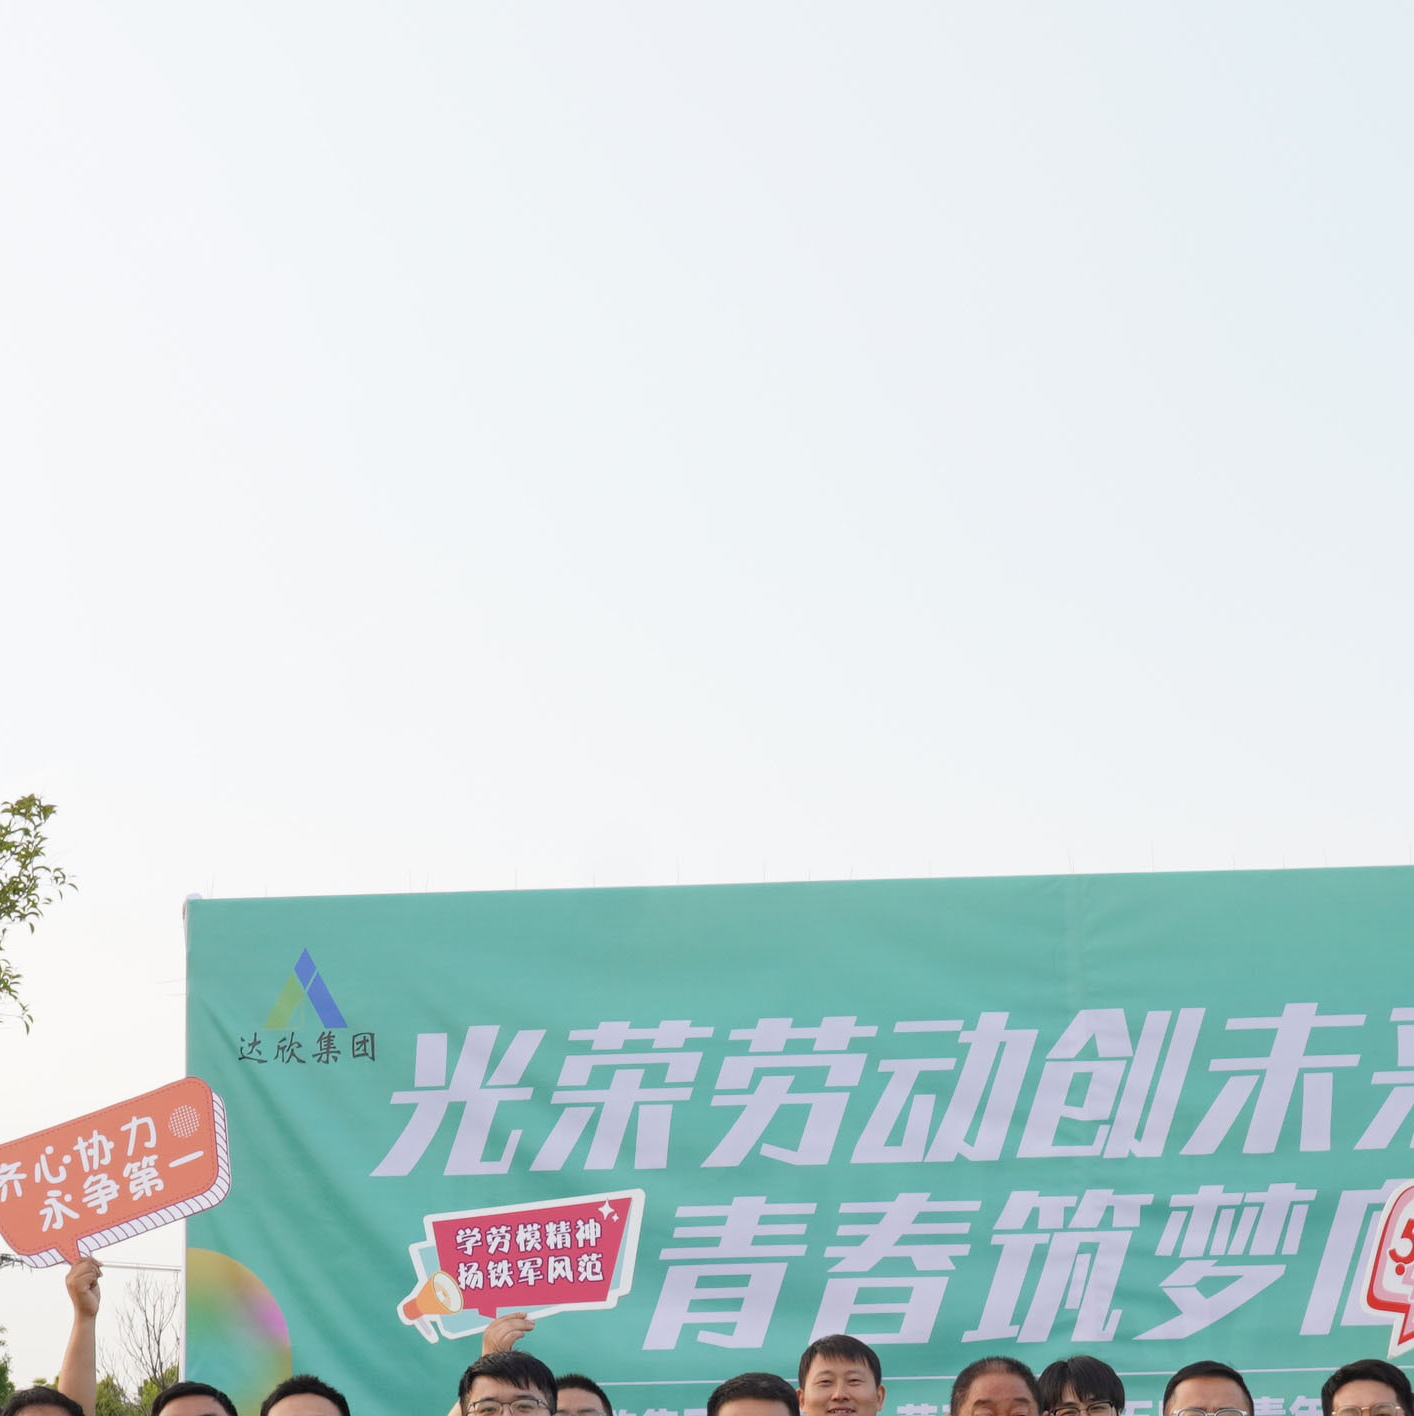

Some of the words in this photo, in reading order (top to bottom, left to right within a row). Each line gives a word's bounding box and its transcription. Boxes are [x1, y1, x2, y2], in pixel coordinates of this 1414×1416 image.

[238, 1032, 375, 1064] 达欣集团
[39, 1151, 204, 1232] 永争第一
[455, 1218, 602, 1256] 学劳模精神
[457, 1253, 604, 1290] 扬铁军风范
